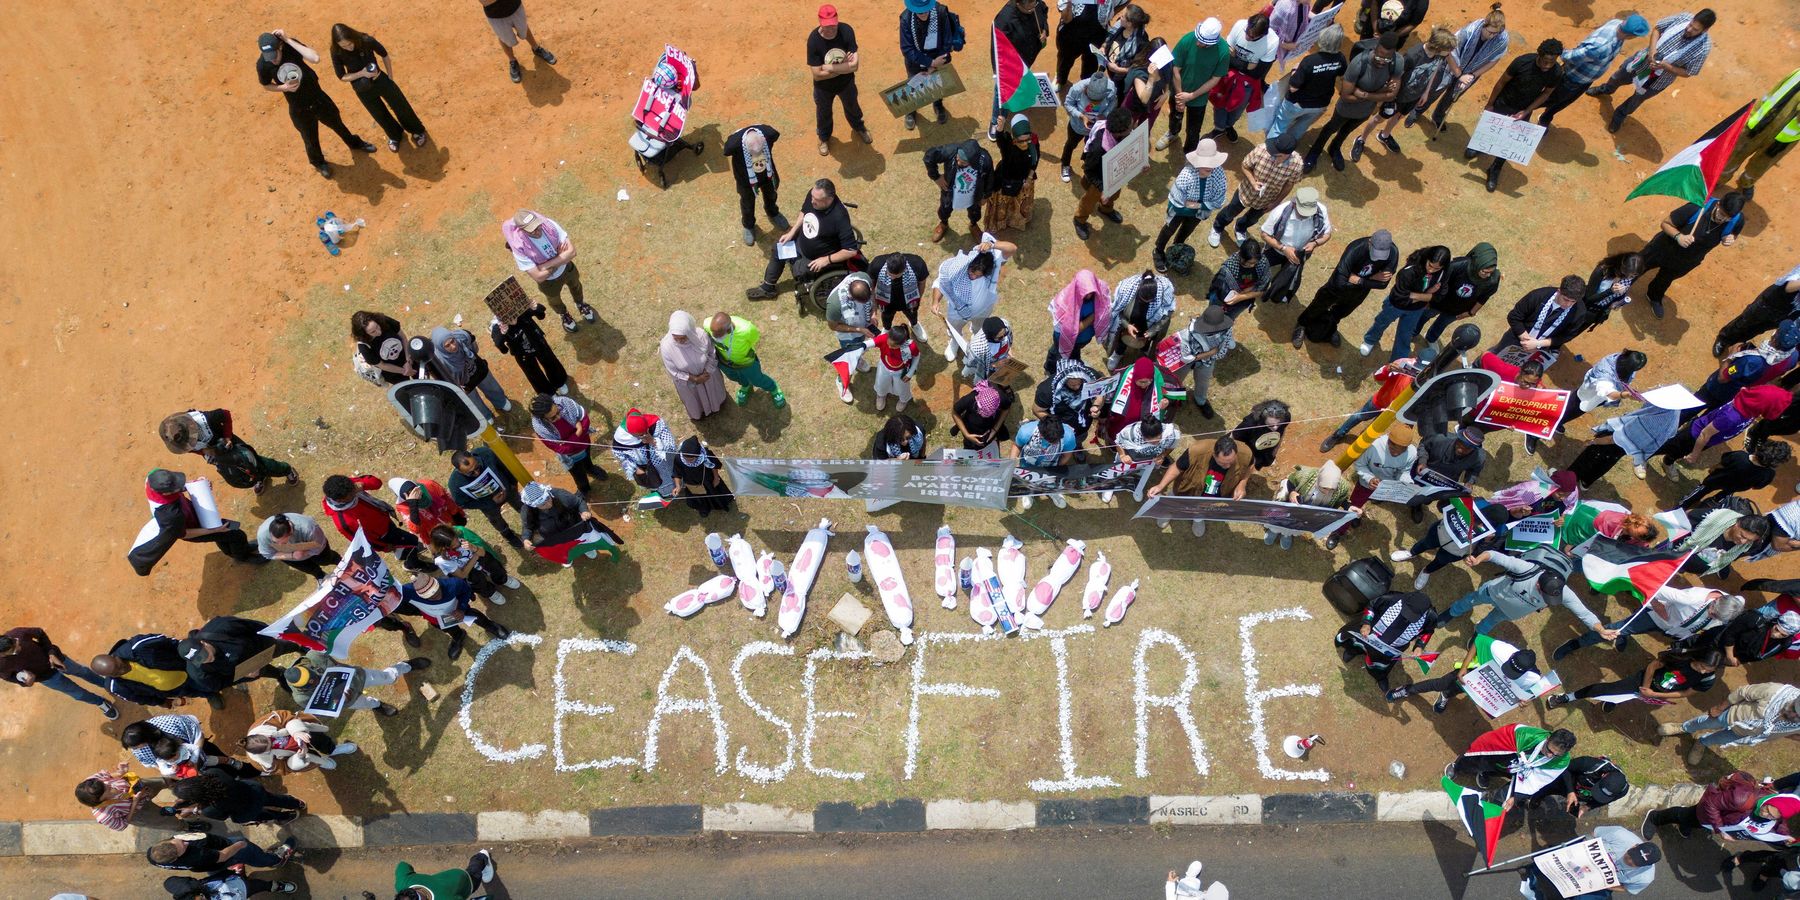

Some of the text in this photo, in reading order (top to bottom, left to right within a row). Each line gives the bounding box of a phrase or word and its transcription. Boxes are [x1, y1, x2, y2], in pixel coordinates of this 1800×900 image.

[1500, 149, 1526, 163] THIS
[1499, 395, 1558, 411] EXPROPRIATE
[1507, 405, 1541, 416] ZIONIST
[1490, 410, 1549, 426] INVESTMENTS
[903, 482, 1005, 493] APARTHEID
[910, 475, 1002, 485] BOYCOTT
[920, 489, 986, 500] ISRAEL
[1477, 682, 1498, 702] ETHNIC
[1478, 674, 1505, 704] STOP THE
[1480, 670, 1514, 705] JERUSALEM
[1488, 670, 1516, 699] DEFEND
[459, 608, 1330, 793] CEASEFIRE
[1466, 680, 1499, 711] CLEANSING
[1160, 806, 1249, 816] NASREC RD
[1587, 841, 1615, 885] WANTED
